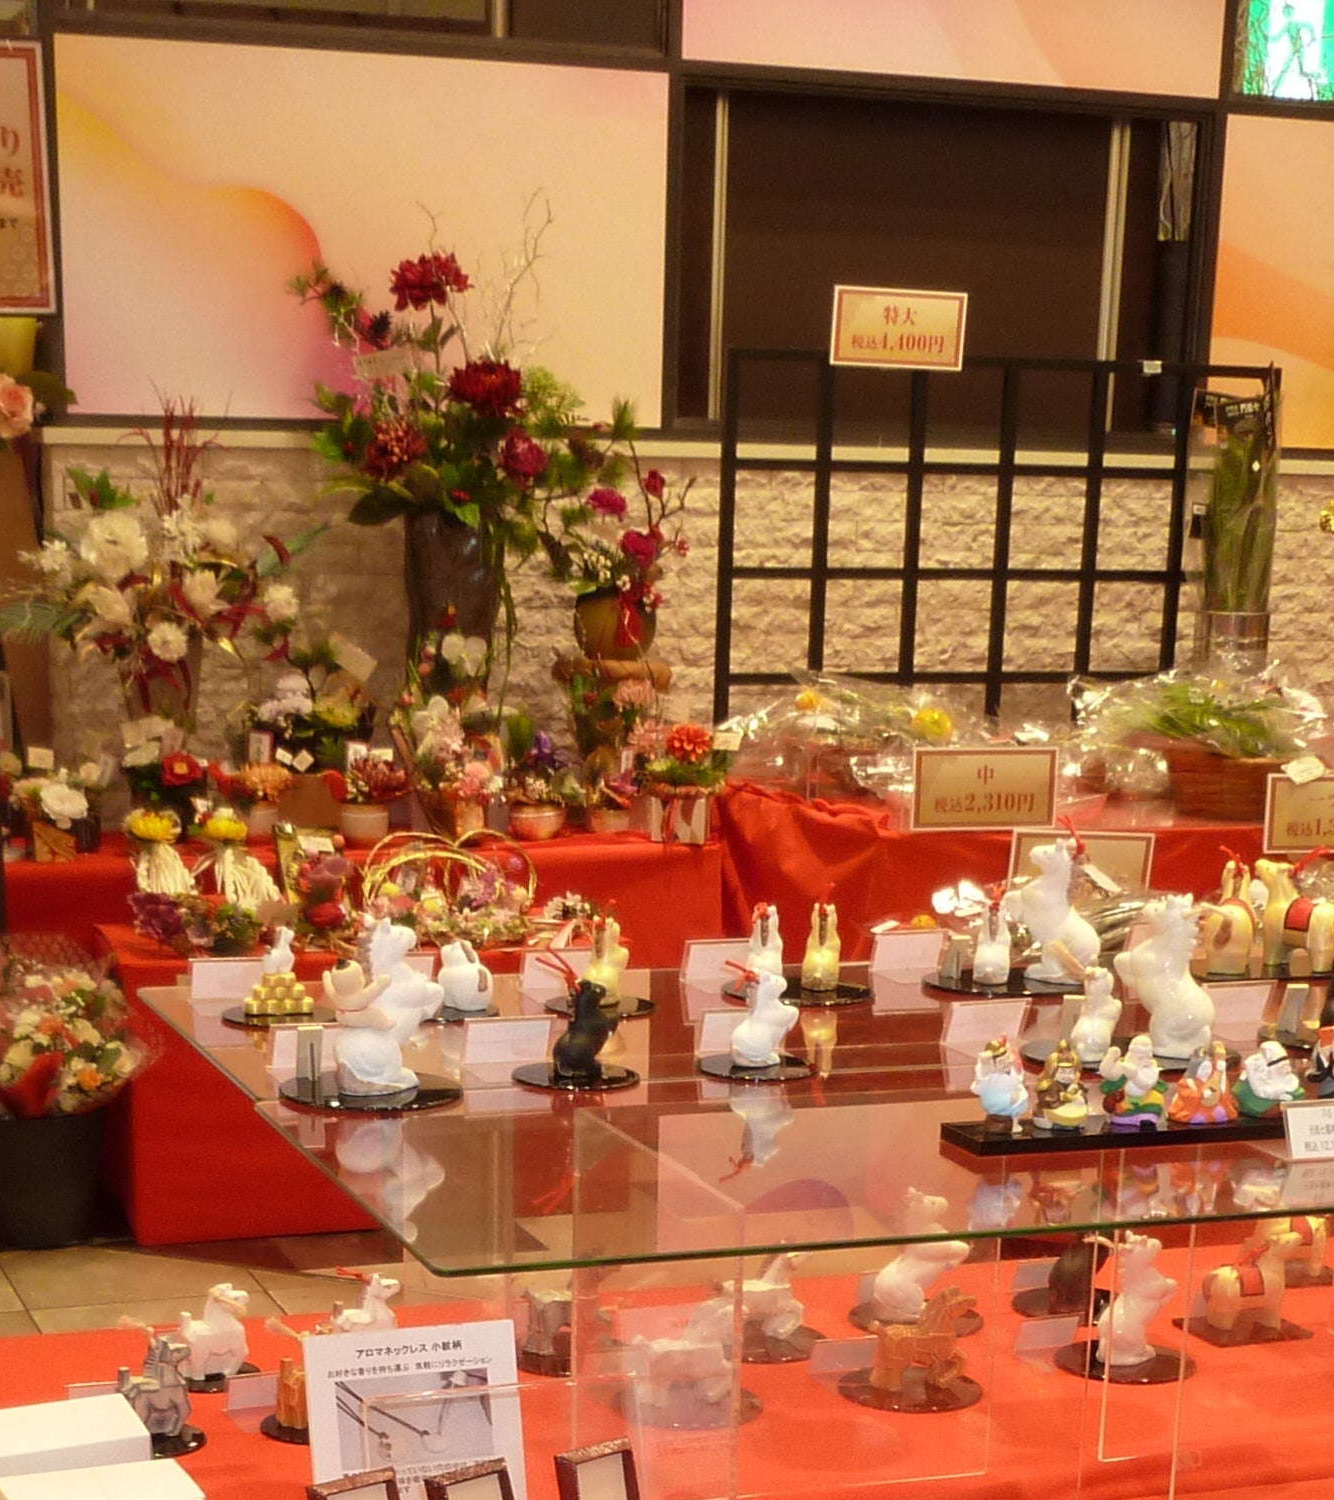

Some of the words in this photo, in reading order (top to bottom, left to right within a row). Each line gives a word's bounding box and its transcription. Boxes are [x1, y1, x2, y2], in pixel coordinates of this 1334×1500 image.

[883, 304, 918, 327] 特大
[977, 764, 994, 785] 中
[934, 793, 1035, 814] 税込2,310円
[355, 1342, 428, 1359] アロマネックレス
